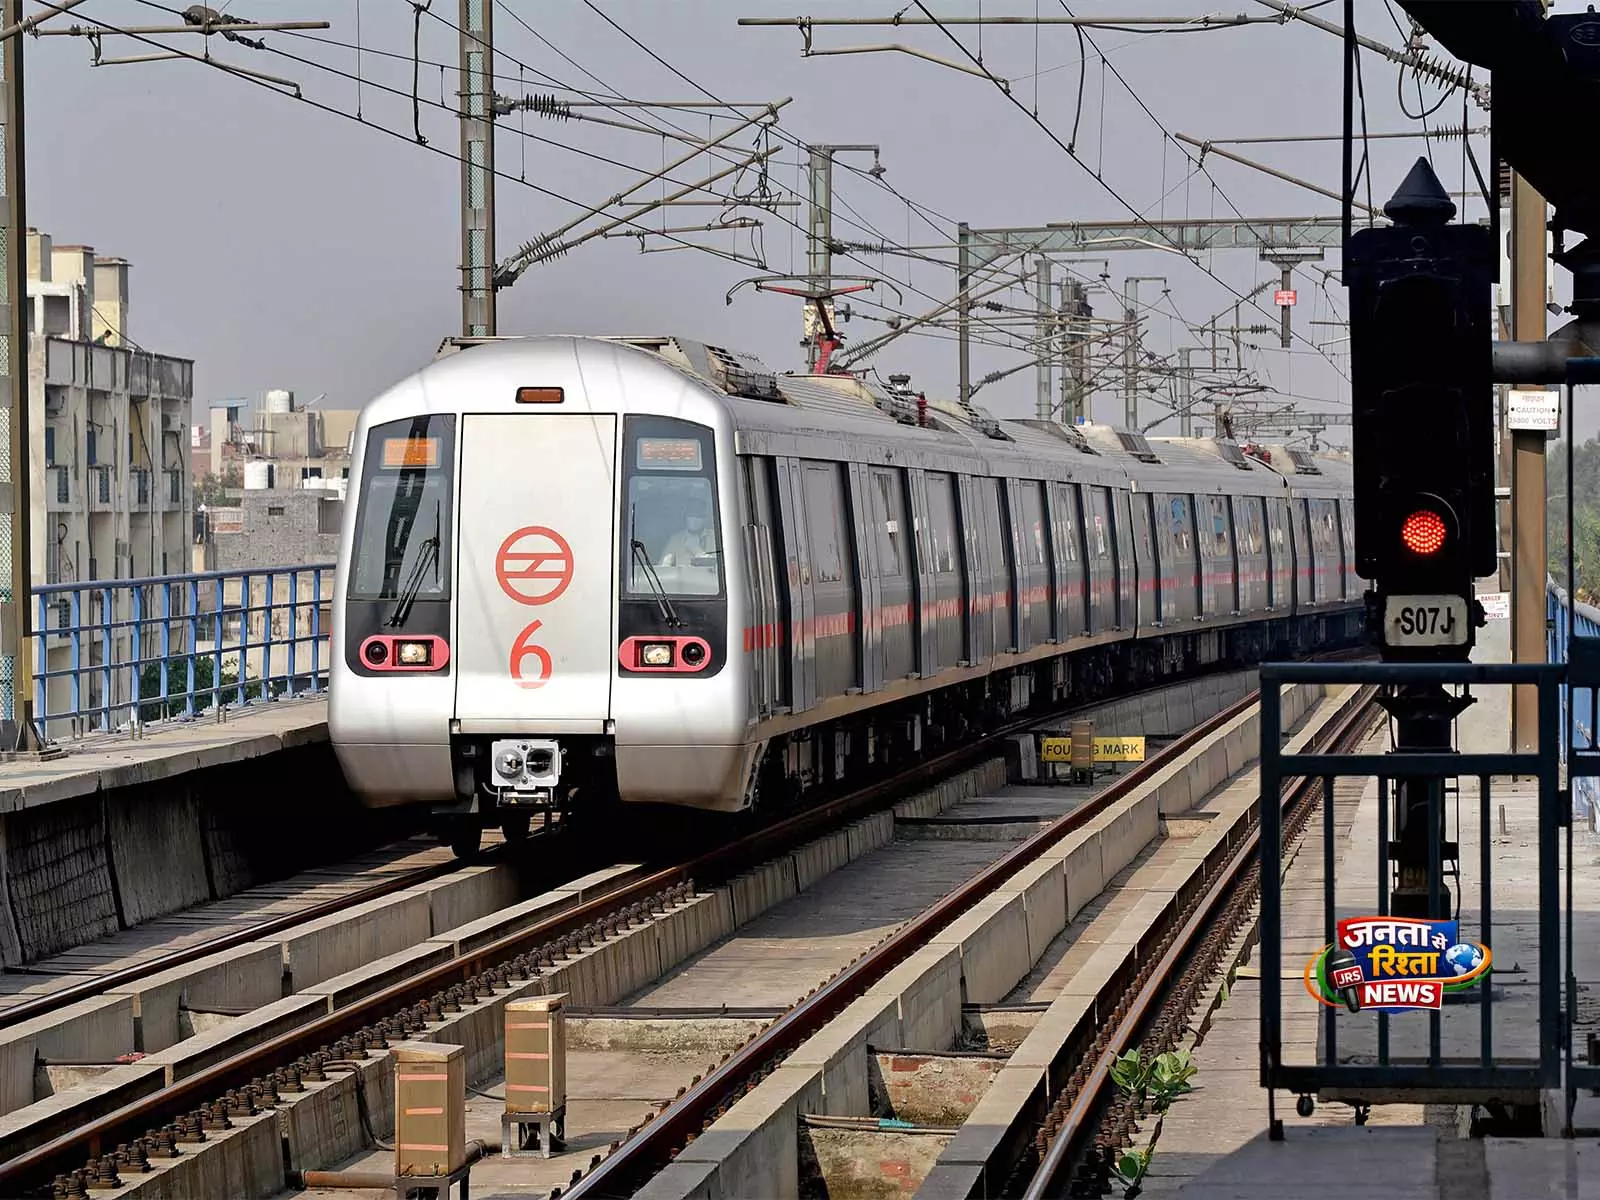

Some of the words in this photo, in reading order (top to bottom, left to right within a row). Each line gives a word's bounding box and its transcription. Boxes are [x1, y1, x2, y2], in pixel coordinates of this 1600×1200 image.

[1532, 417, 1557, 425] VOLTS
[509, 618, 553, 690] 6
[1046, 744, 1099, 756] FOUG
[1103, 743, 1139, 755] MARK
